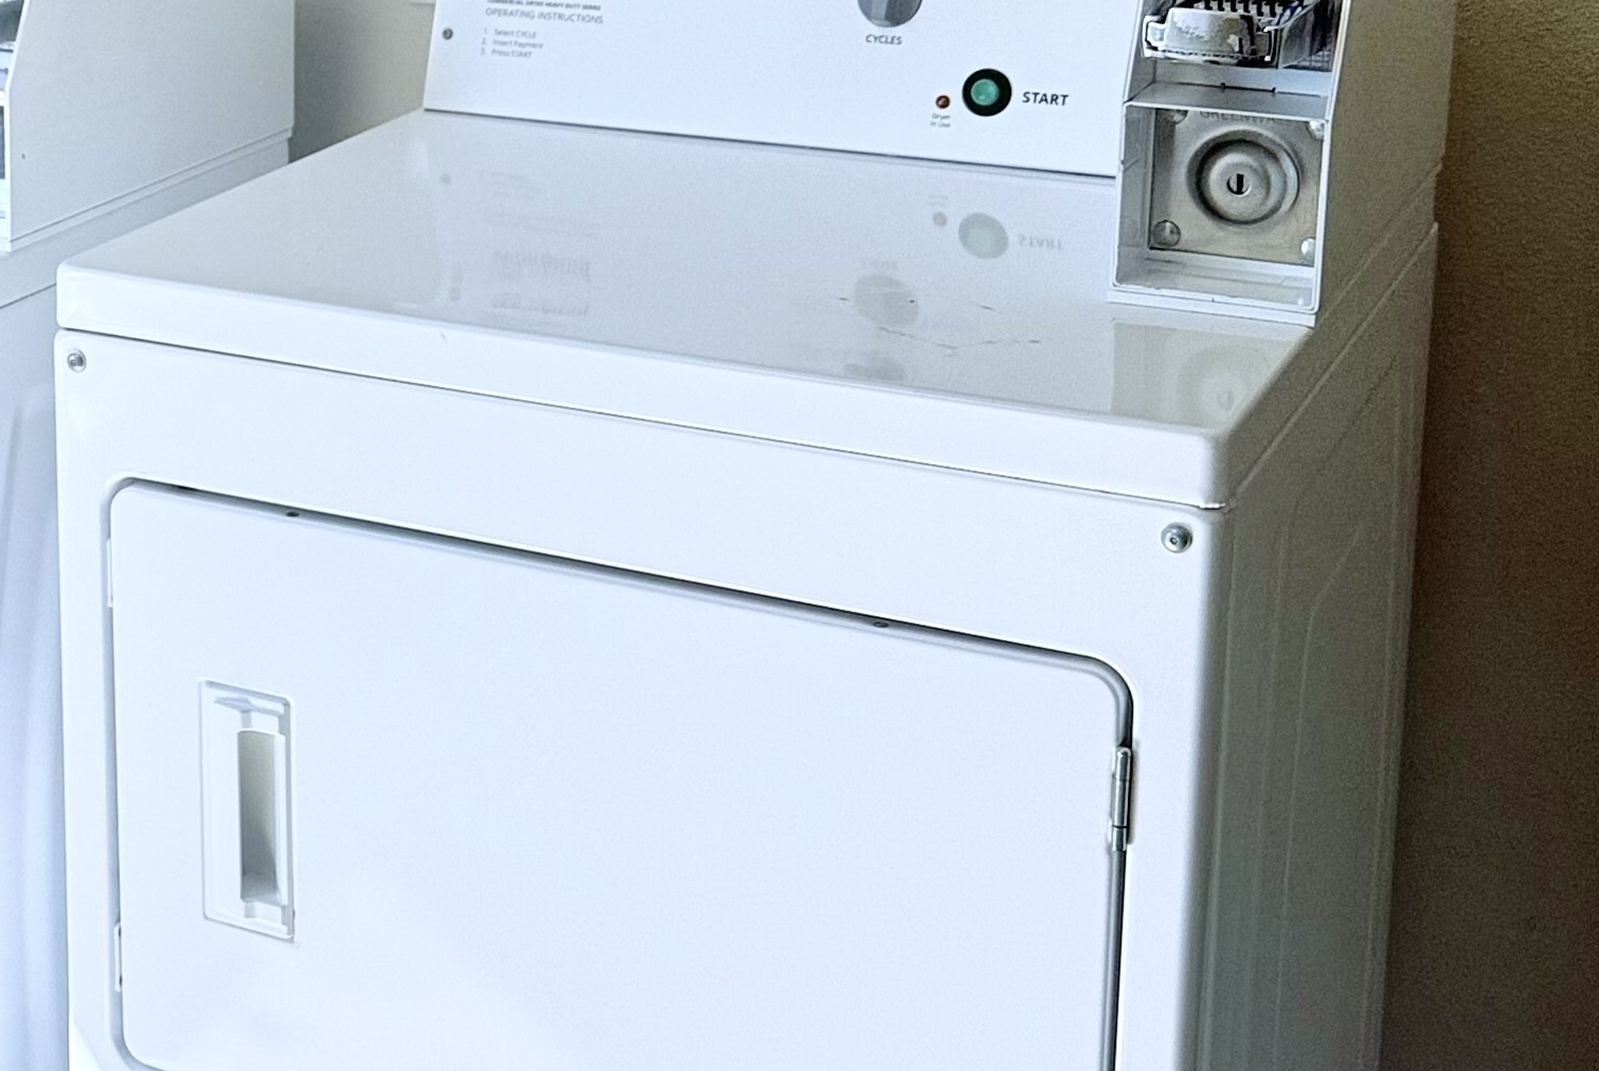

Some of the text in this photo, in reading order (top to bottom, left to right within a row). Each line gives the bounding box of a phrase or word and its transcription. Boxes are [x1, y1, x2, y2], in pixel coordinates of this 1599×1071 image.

[485, 7, 603, 24] OPERATING INSTRUCTIONS
[865, 34, 902, 46] CYCLES
[1022, 91, 1069, 106] START
